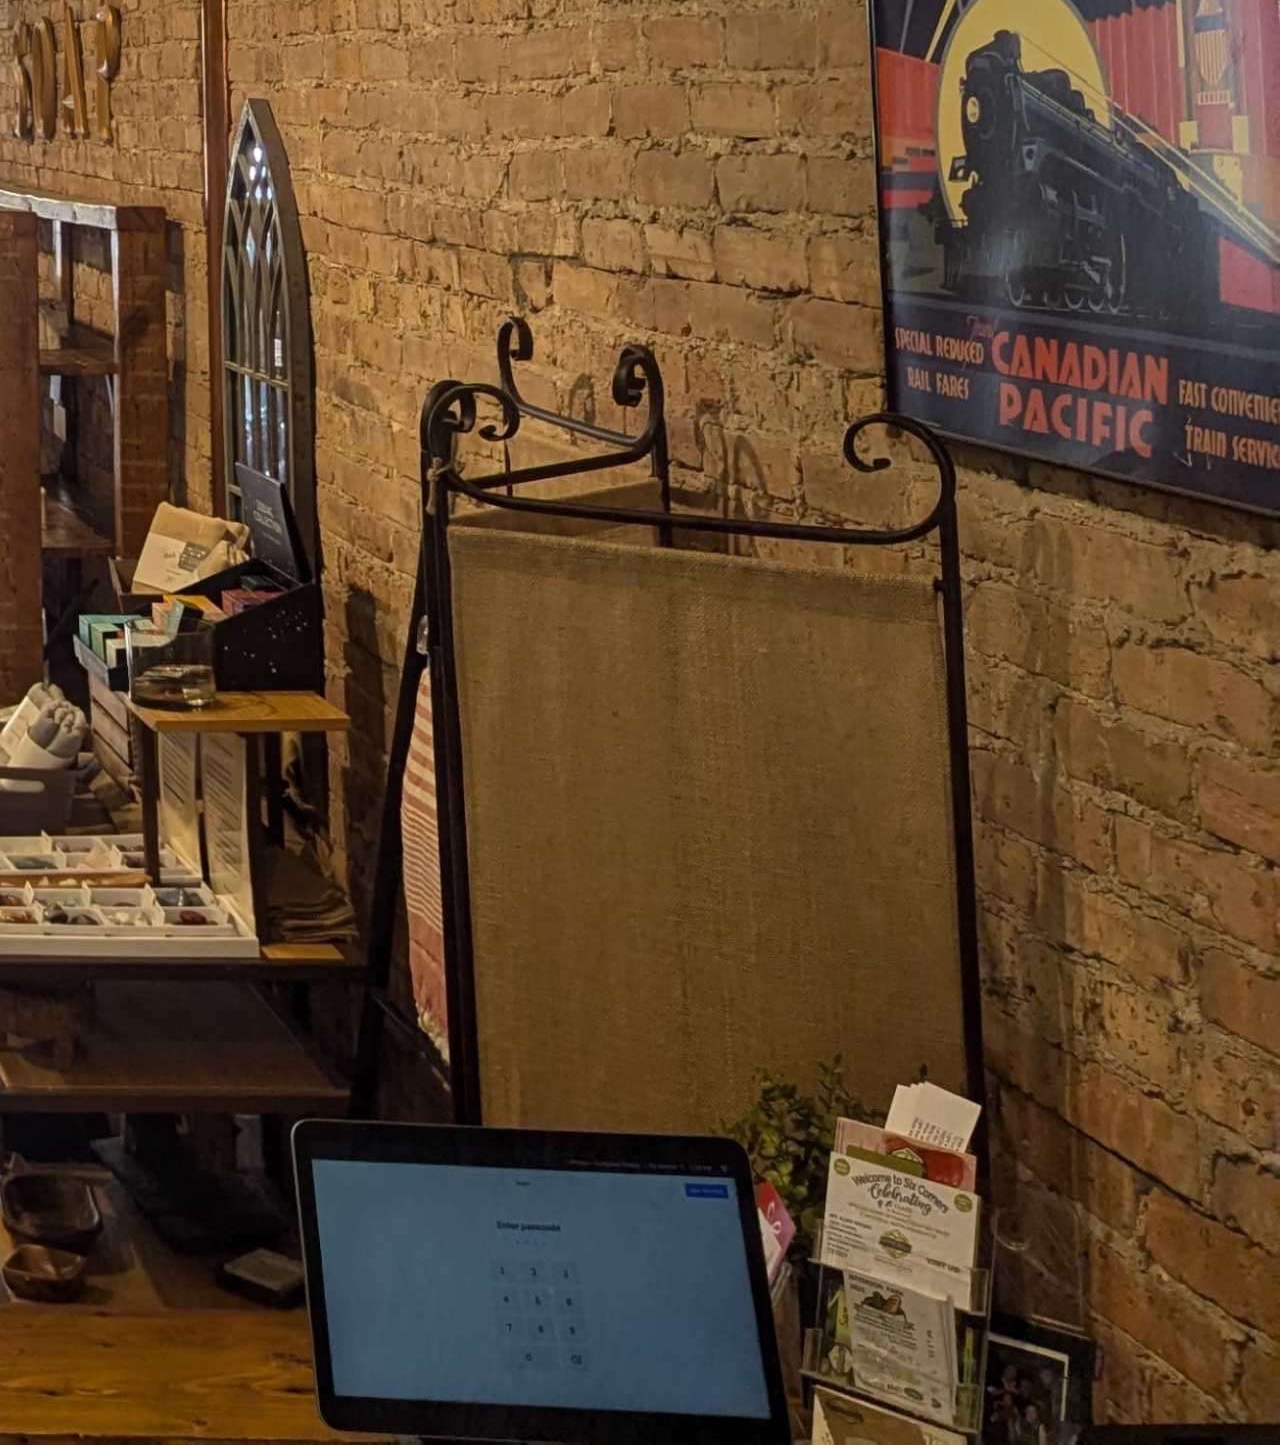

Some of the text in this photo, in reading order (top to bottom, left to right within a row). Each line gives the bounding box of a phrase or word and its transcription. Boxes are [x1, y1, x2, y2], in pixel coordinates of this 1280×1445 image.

[895, 328, 985, 364] SPECIAL REDUCED
[907, 366, 970, 400] RAIL FARES
[991, 331, 1169, 405] CANADIAN
[1179, 379, 1209, 409] FAST
[999, 382, 1154, 458] PACIFIC
[1184, 424, 1228, 458] TRAIN
[851, 1174, 892, 1186] Welcome
